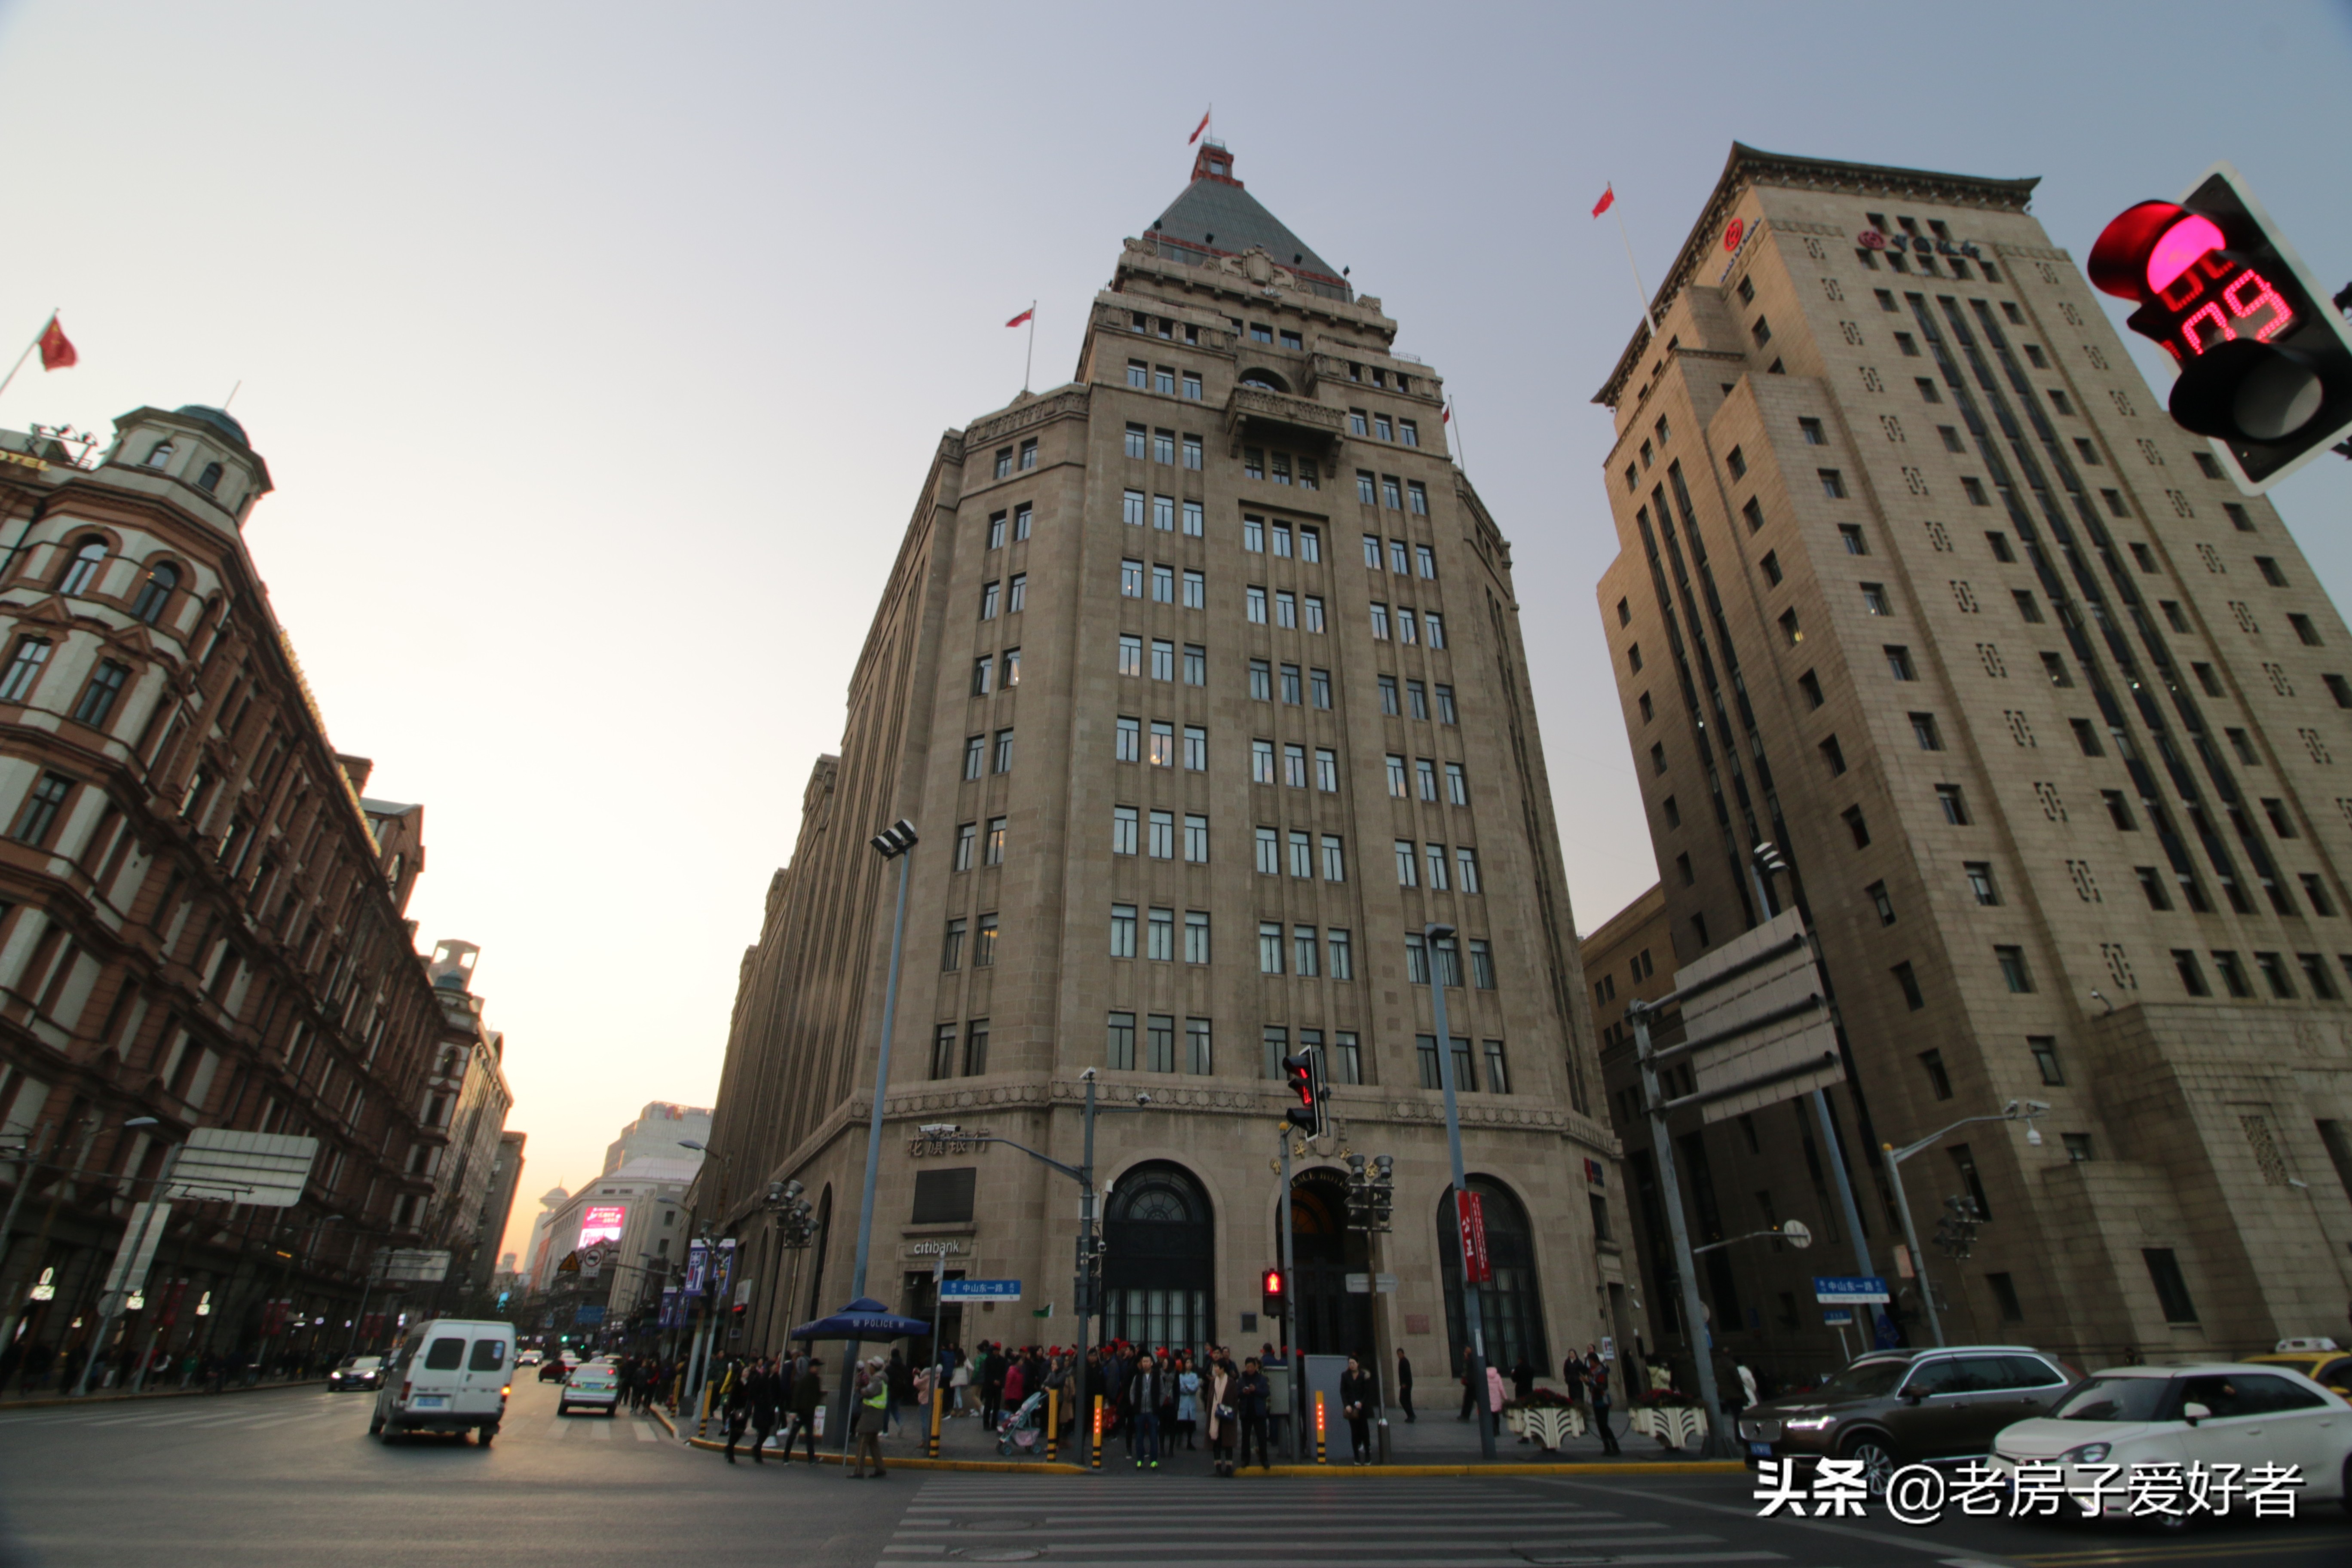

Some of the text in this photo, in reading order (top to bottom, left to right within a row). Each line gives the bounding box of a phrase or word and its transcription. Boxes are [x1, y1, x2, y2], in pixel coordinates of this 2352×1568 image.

[914, 1239, 959, 1254] citibank
[963, 1283, 1003, 1293] 中山东一路
[1828, 1281, 1873, 1291] 中山东一路
[864, 1320, 894, 1328] POLICE
